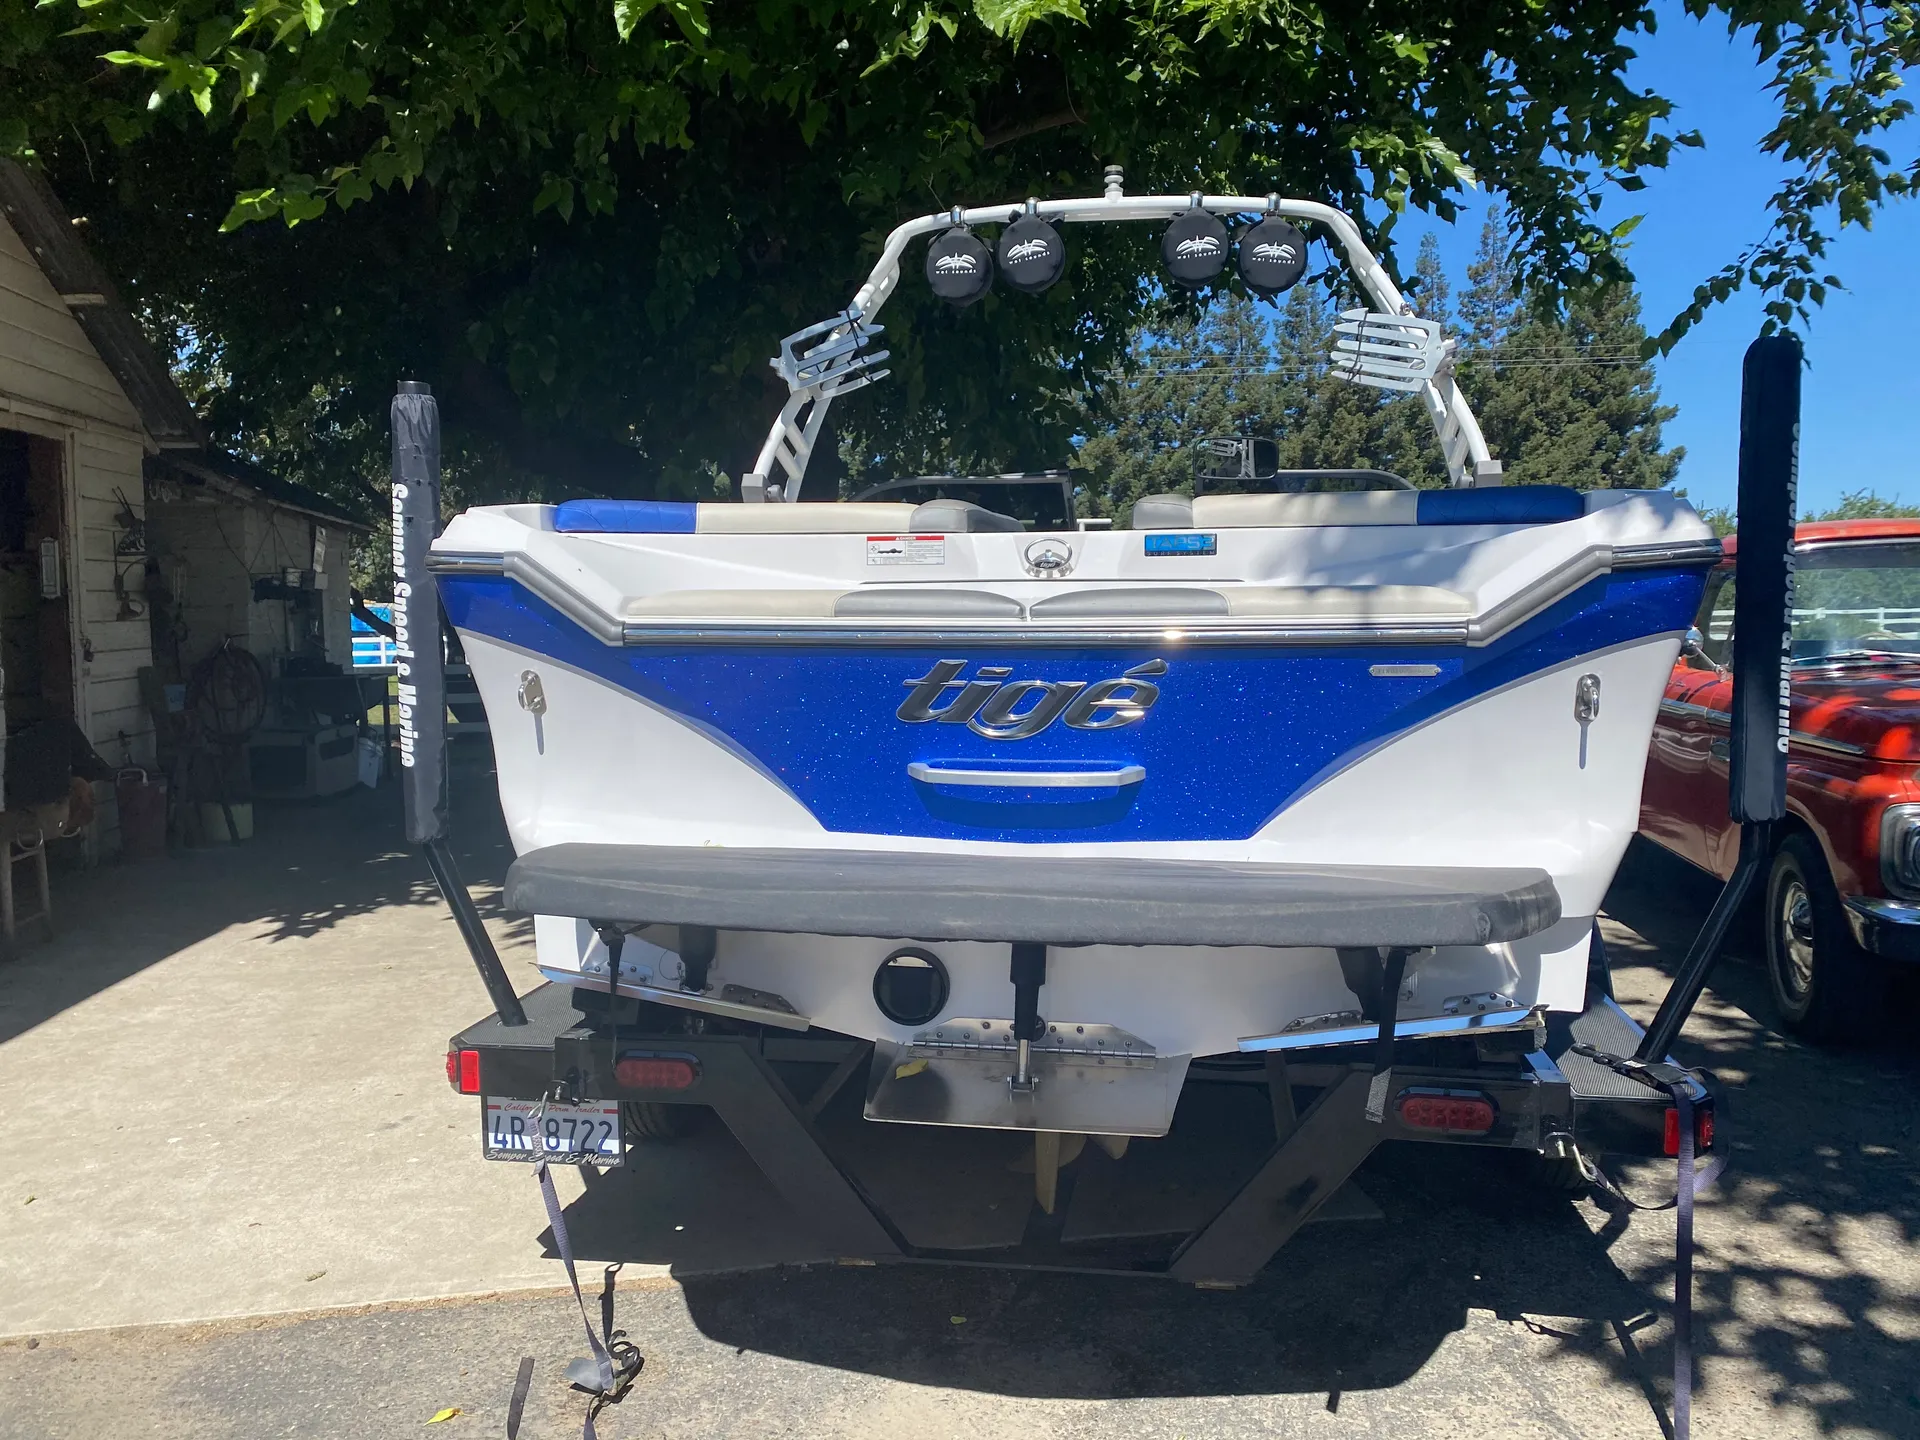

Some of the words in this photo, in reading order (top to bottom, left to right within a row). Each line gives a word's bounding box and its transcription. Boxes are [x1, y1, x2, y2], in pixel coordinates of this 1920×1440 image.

[397, 683, 419, 768] Marine
[896, 658, 1168, 741] tigé
[493, 1115, 613, 1154] 4R8722
